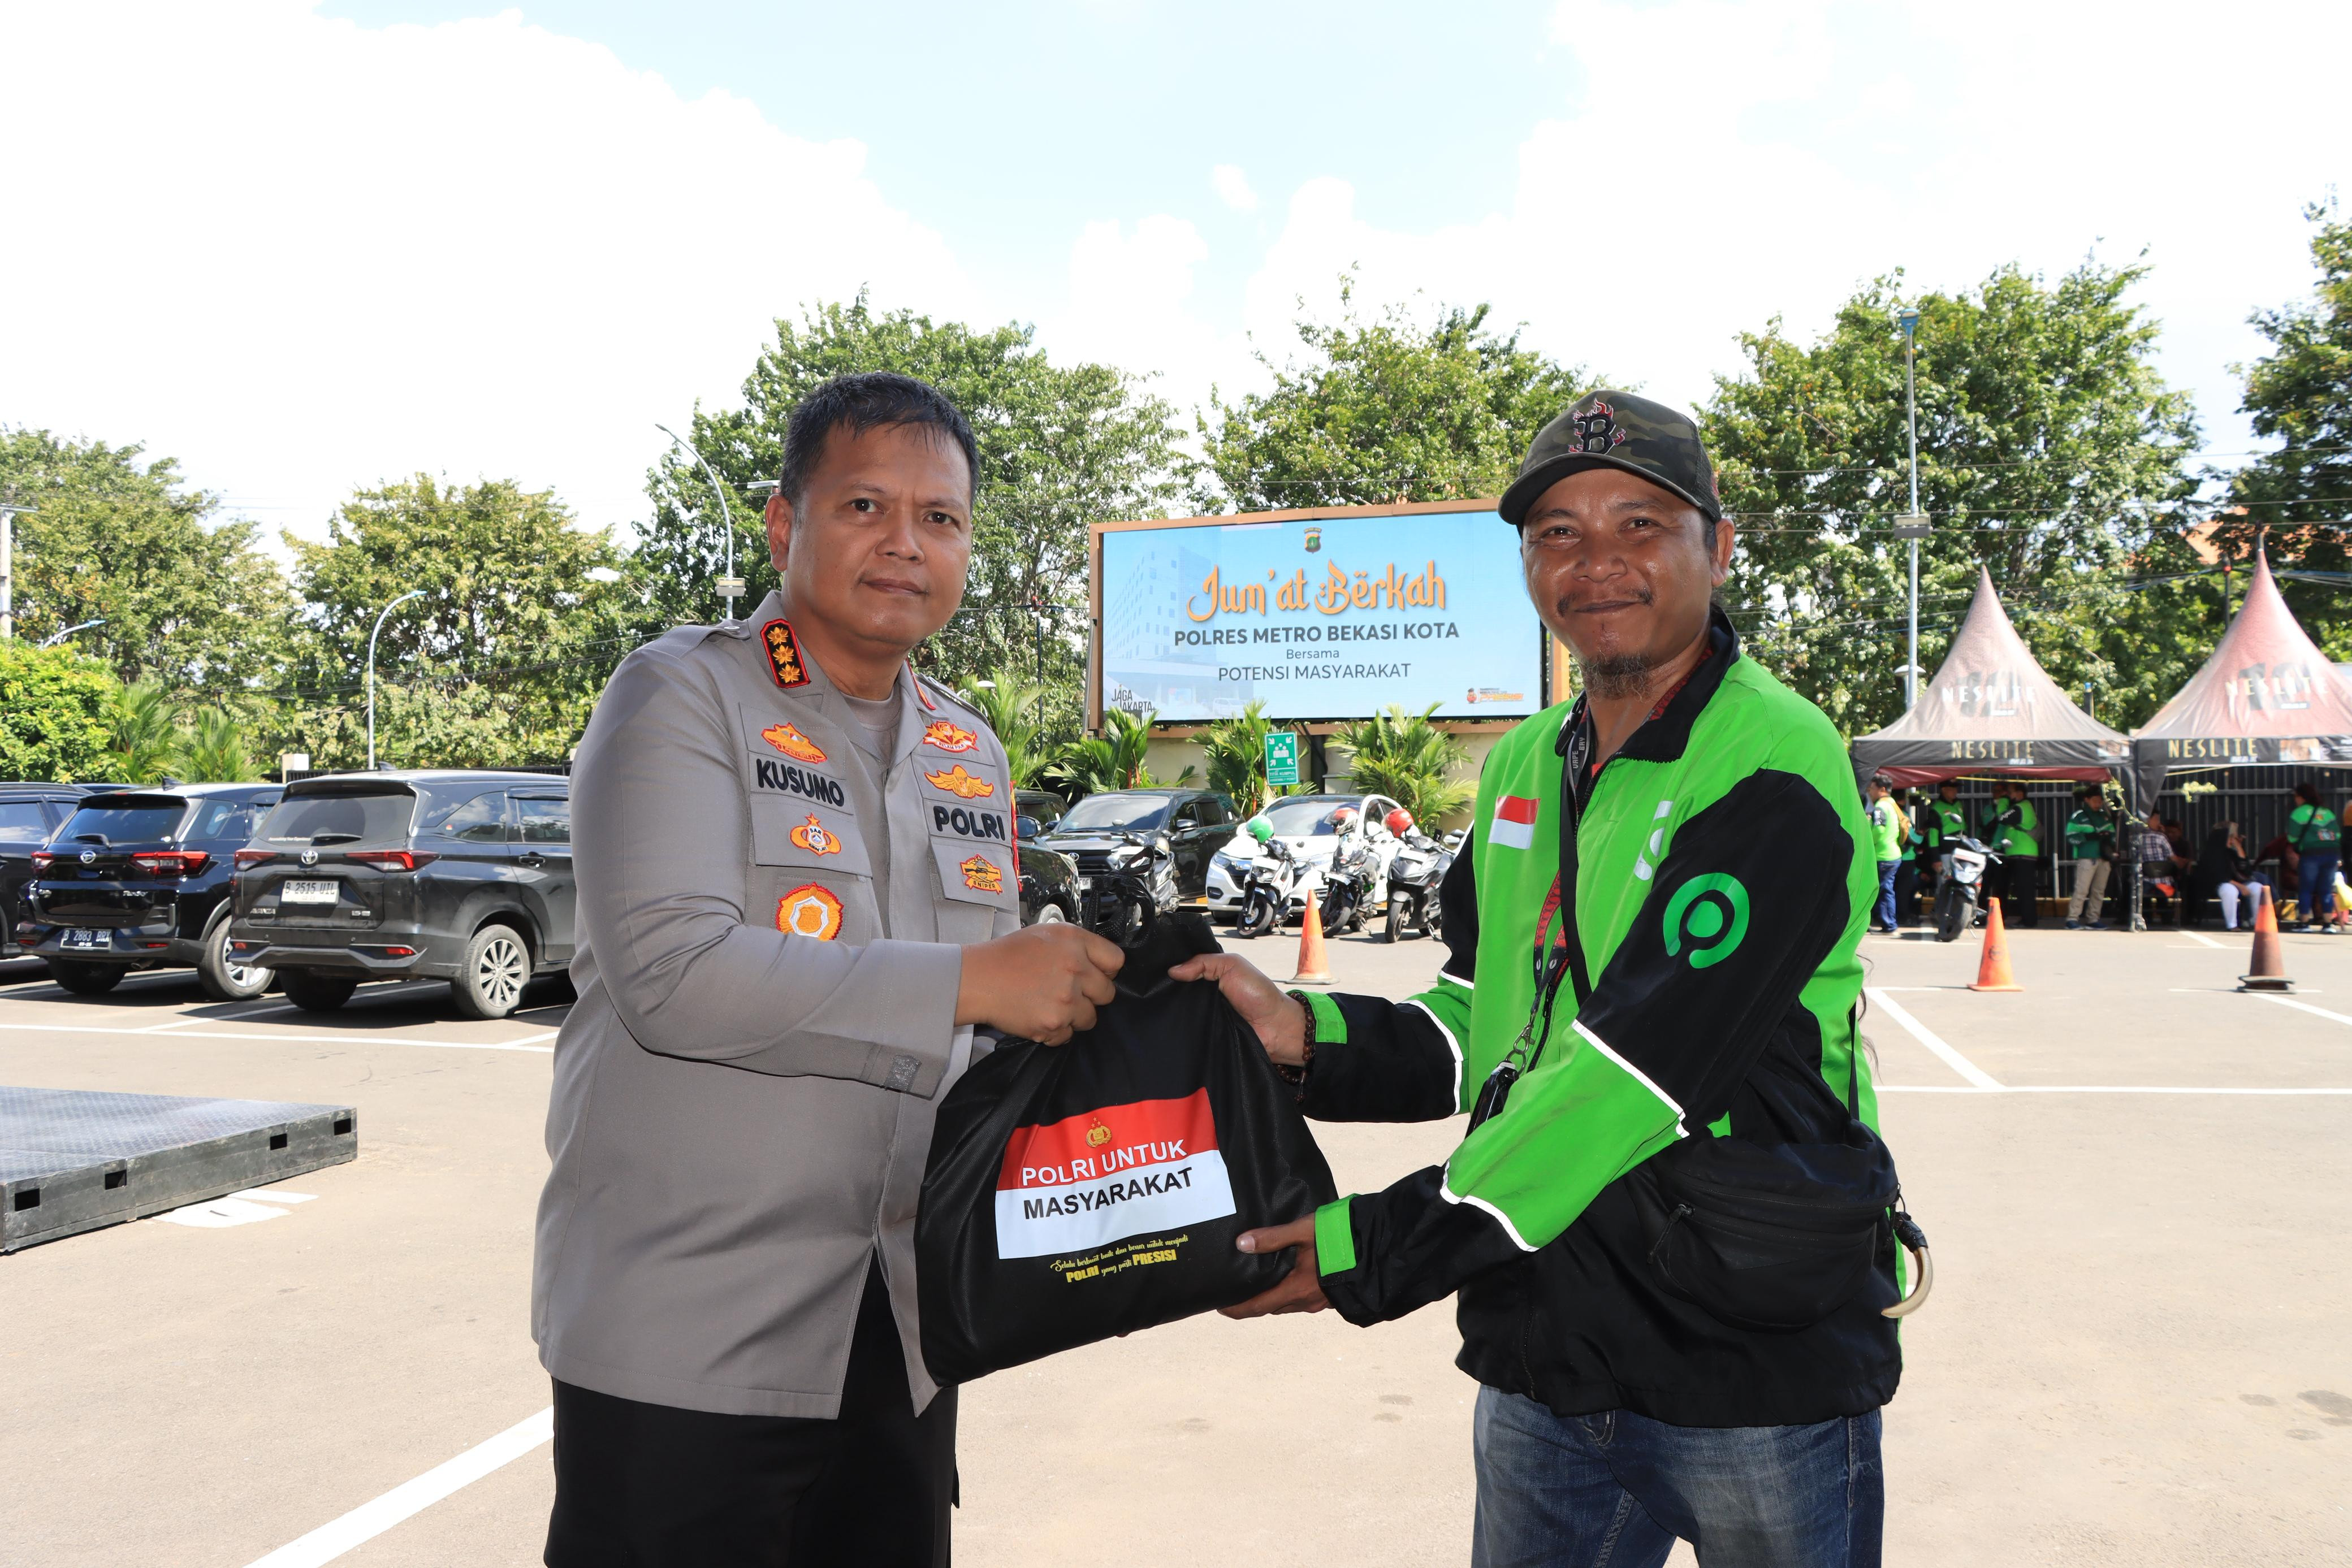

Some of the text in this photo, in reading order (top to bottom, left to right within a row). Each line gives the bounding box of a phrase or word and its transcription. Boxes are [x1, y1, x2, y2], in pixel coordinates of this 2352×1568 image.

[1187, 564, 1309, 622] Jum'at
[1175, 622, 1459, 646] POLRES METRO BEKASI KOTA
[1286, 649, 1339, 659] Bersama
[1218, 663, 1411, 681] POTENSI MASYARAKAT
[1112, 688, 1133, 701] JAGA
[1942, 686, 2035, 702] NESLITE
[2225, 677, 2328, 696] NESLITE
[1952, 741, 2034, 759] NESLITE
[2168, 738, 2258, 758] NESLITE
[756, 759, 844, 807] KUSUMO
[933, 805, 1005, 841] POLRI
[286, 882, 335, 895] B 2515 UIL
[63, 930, 111, 942] B 2883 BRX
[1023, 1139, 1187, 1186] POLRI UNTUK
[1024, 1167, 1192, 1219] MASYARAKAT
[1050, 1259, 1075, 1272] Selalu
[1076, 1254, 1099, 1267] berbuat
[1101, 1250, 1114, 1260] baik
[1115, 1247, 1127, 1256] dan
[1147, 1238, 1164, 1249] untuk
[1165, 1234, 1188, 1248] menjadi
[1066, 1249, 1177, 1283] POLRI yang pasti PRESISI
